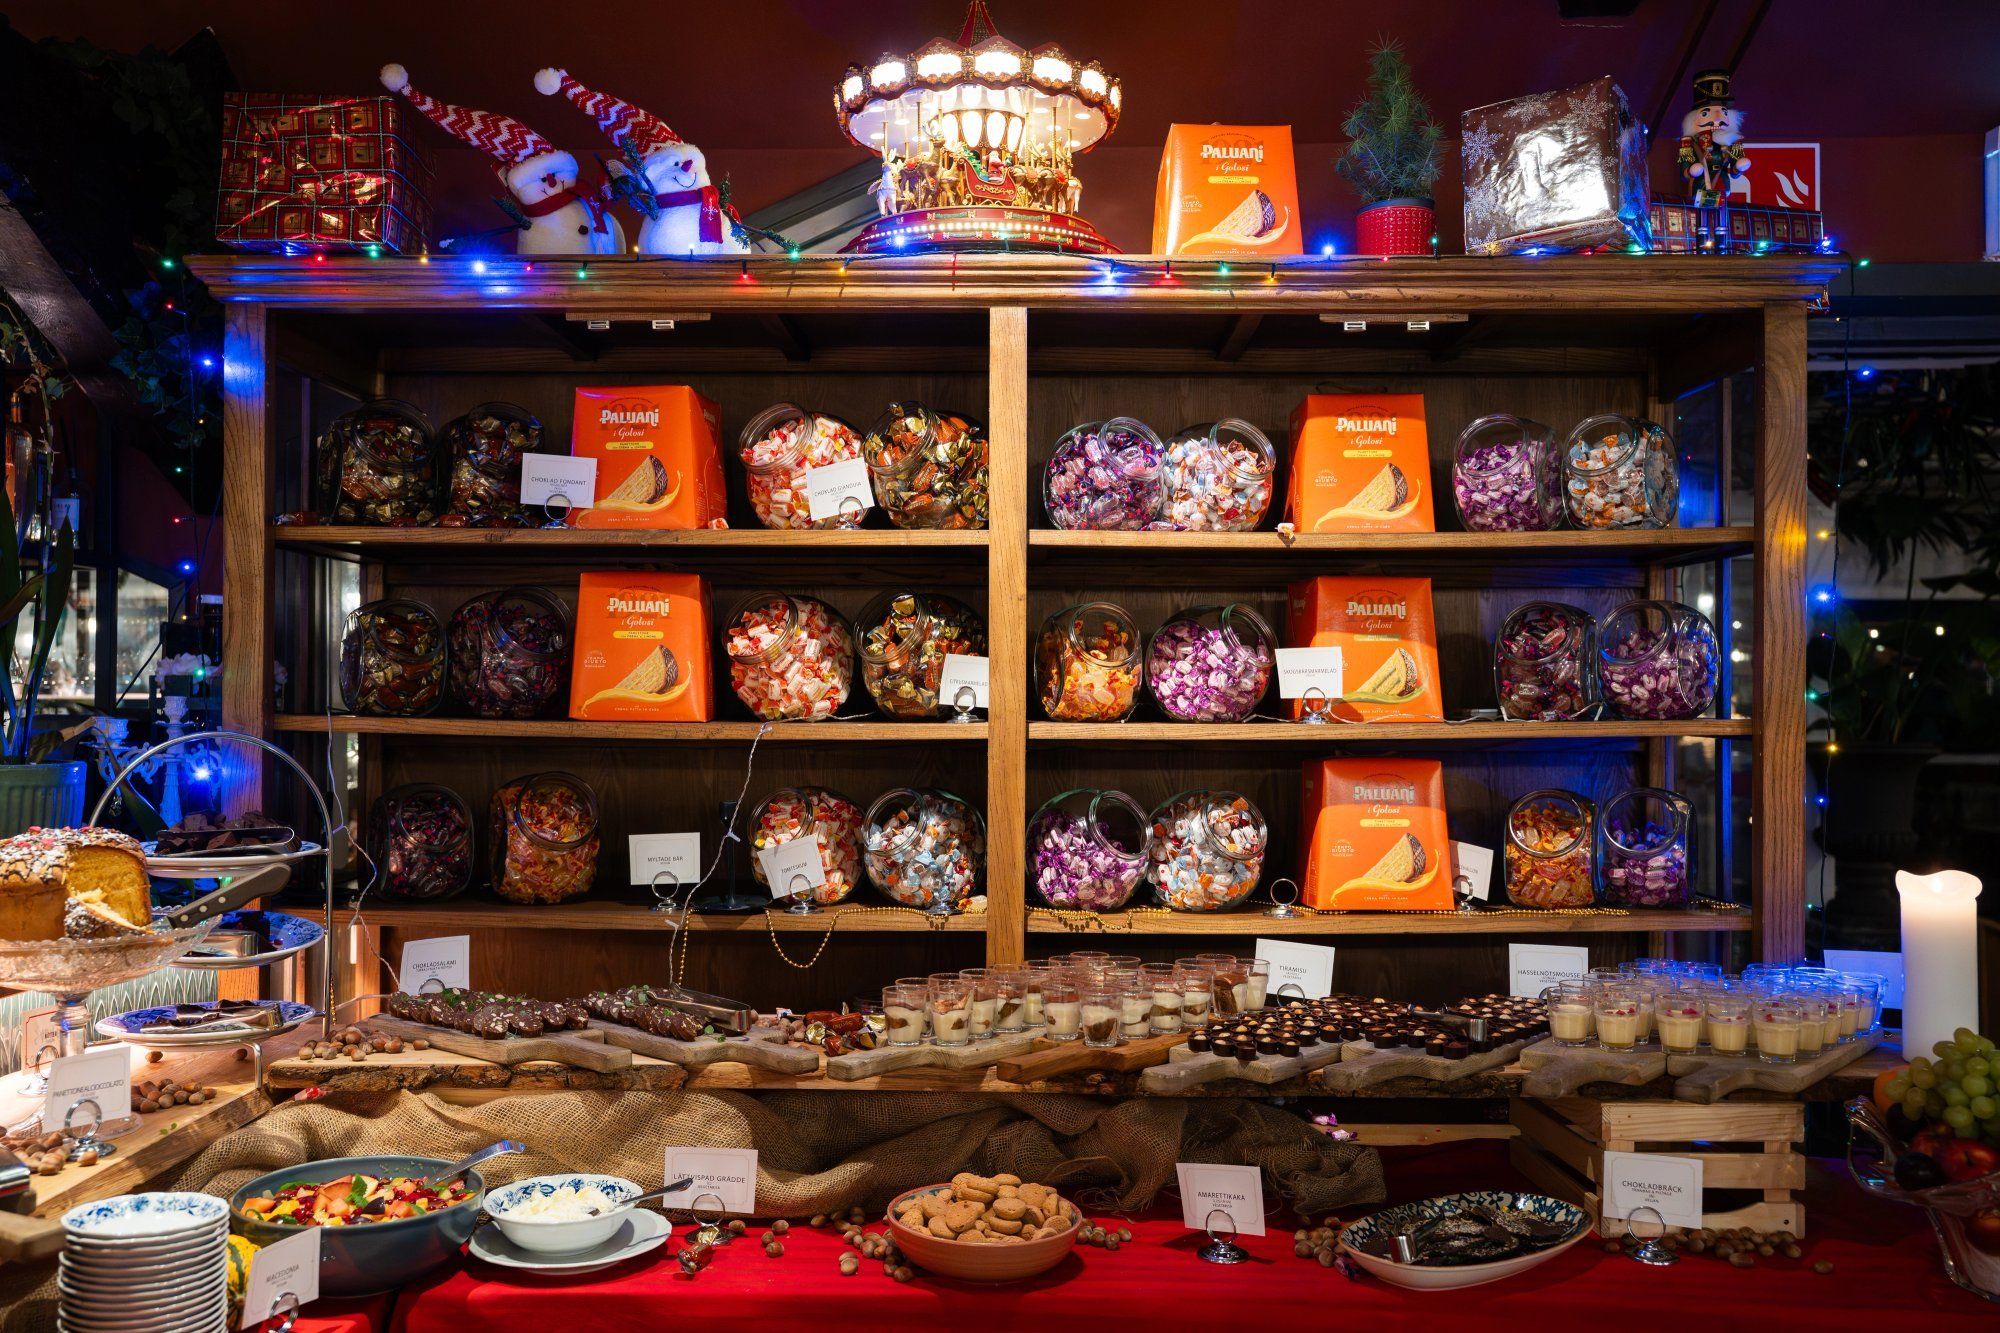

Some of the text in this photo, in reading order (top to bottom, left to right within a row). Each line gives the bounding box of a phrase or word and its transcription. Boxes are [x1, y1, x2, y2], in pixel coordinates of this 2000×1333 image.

[1221, 162, 1250, 174] Golosi
[618, 427, 645, 440] Golosi
[1356, 435, 1383, 448] Golosi
[559, 478, 587, 486] FONDANT
[626, 616, 655, 628] Golosi
[1366, 620, 1393, 632] Golosi
[1372, 804, 1401, 817] Golosi
[412, 960, 457, 969] CHOKLADSALAMI
[1279, 965, 1307, 974] TIRAMISU
[1197, 1191, 1246, 1200] AMARETTIKAKA
